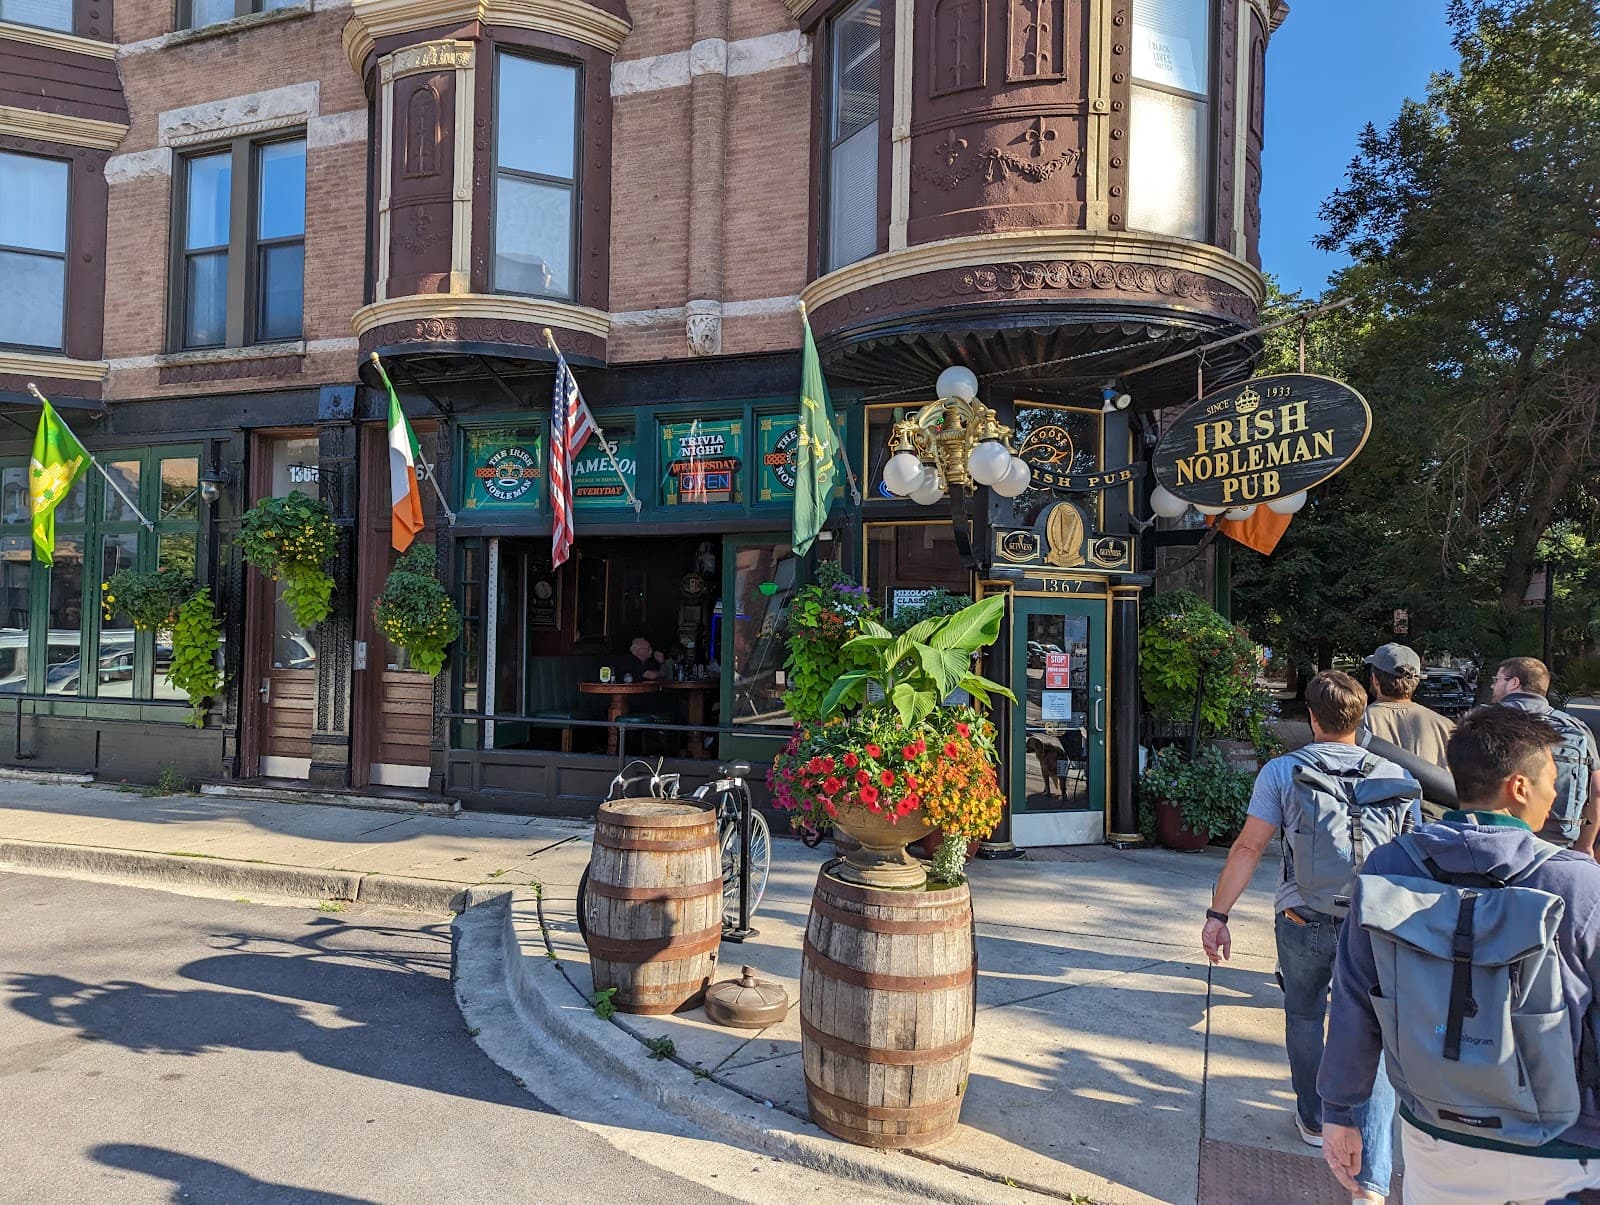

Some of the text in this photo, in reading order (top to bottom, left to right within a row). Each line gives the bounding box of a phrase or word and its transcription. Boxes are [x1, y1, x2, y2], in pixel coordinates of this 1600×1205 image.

[1266, 386, 1292, 398] 1933
[1206, 398, 1230, 416] SINCE
[1193, 400, 1309, 456] IRISH
[679, 434, 725, 446] TRIVIA
[777, 430, 797, 450] THE
[1030, 429, 1068, 446] GOOSE
[489, 448, 534, 467] THE IRISH
[681, 445, 723, 457] NIGHT
[1175, 429, 1335, 486] NOBLEMAN
[416, 464, 434, 481] 67
[571, 457, 636, 476] AMESON
[682, 474, 729, 490] OEN
[1032, 469, 1132, 488] ISH PUB
[1221, 470, 1281, 503] PUB
[486, 479, 532, 500] NOBLEMAN
[576, 486, 622, 496] EVERYDAY
[1042, 578, 1082, 593] 1367
[1050, 656, 1065, 664] STOP
